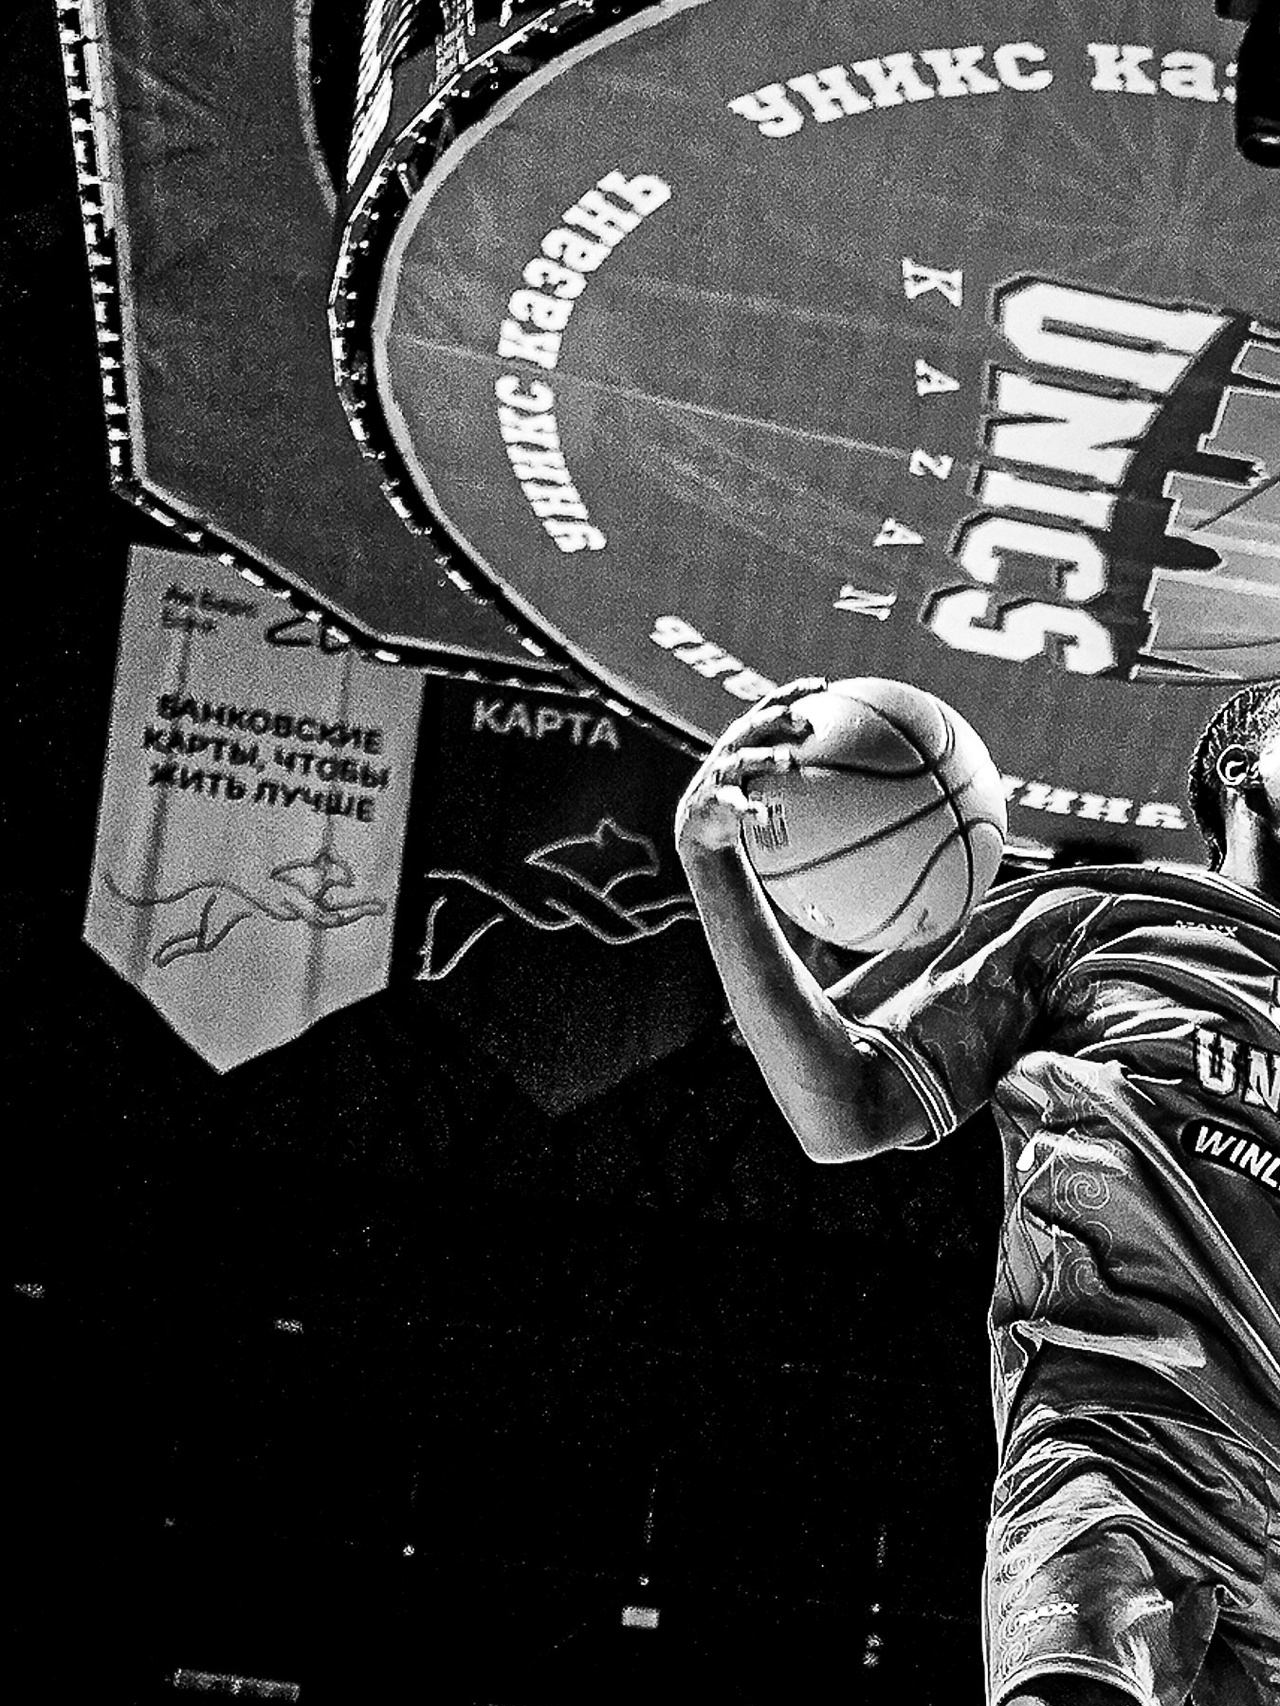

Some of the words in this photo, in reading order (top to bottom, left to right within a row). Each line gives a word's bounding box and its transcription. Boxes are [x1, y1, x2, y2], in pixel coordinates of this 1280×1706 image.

[930, 280, 1232, 676] UNICS
[158, 694, 383, 754] БАНКОВСКИЕ
[473, 699, 621, 751] КАРТА
[144, 726, 265, 773] КАРТЫ,
[273, 748, 391, 791] ЧТОБЫ
[150, 761, 247, 801] ЖИТЬ
[253, 780, 376, 824] ЛУЧШЕ
